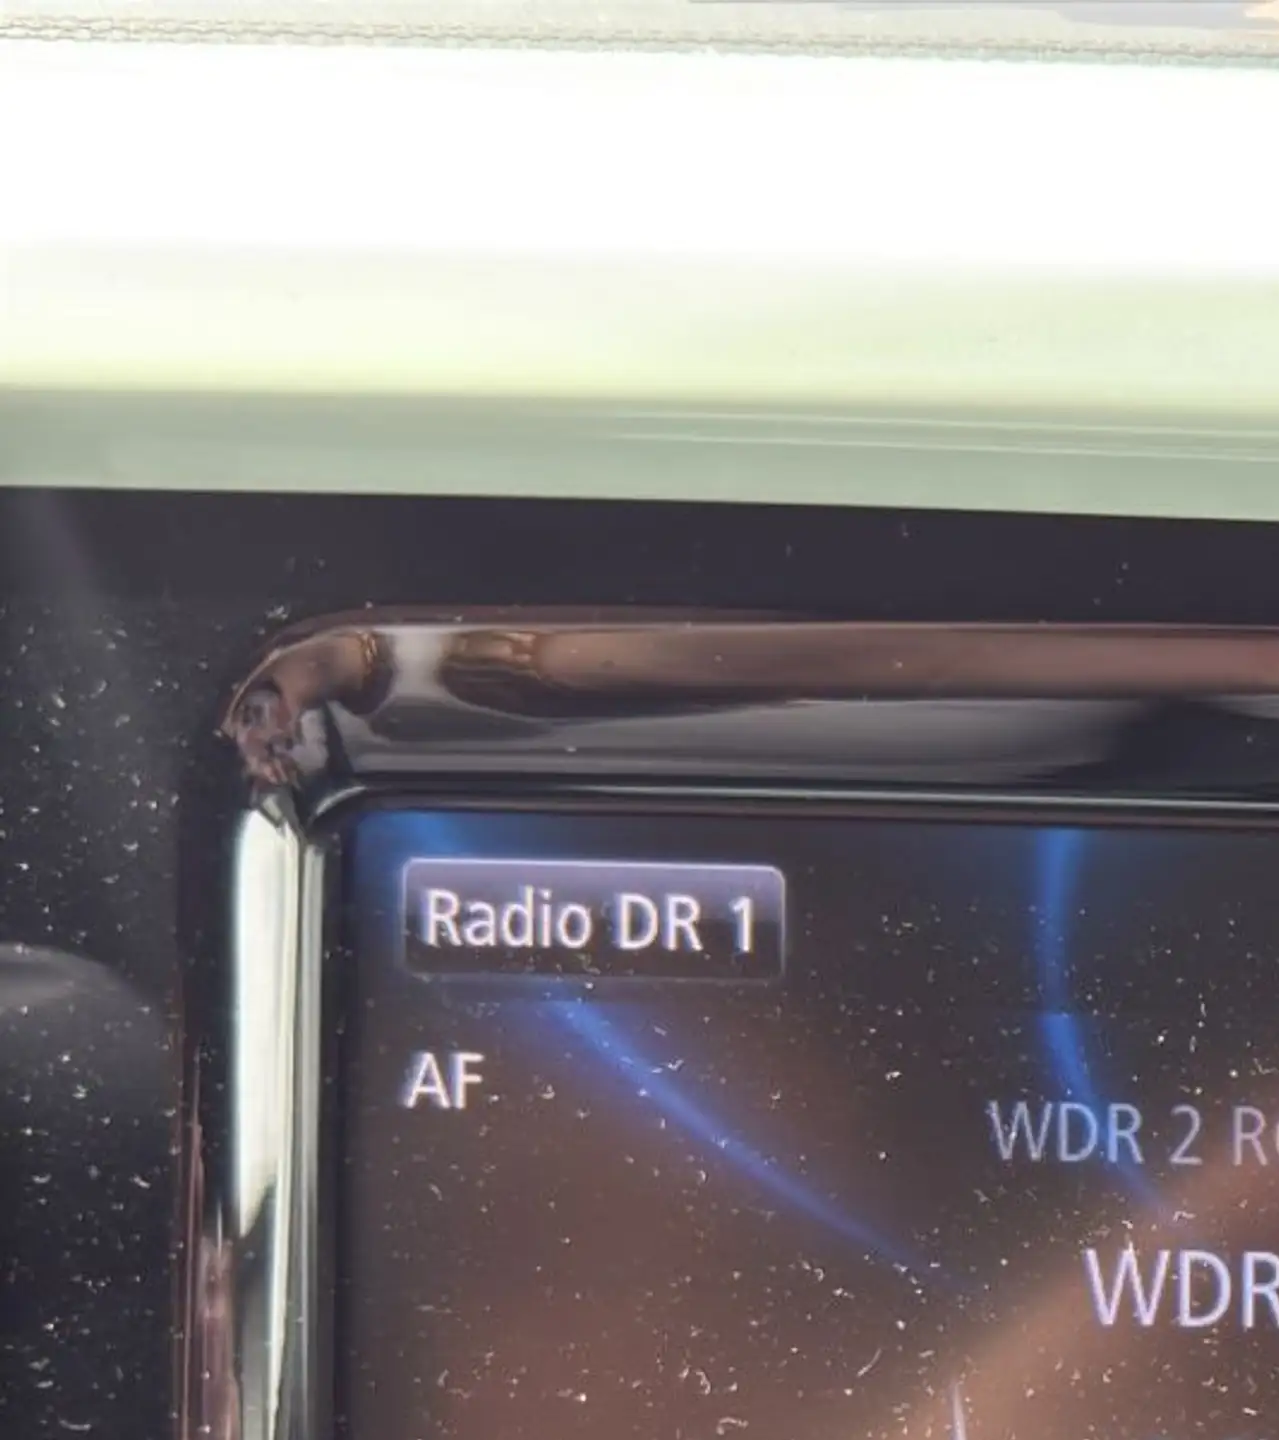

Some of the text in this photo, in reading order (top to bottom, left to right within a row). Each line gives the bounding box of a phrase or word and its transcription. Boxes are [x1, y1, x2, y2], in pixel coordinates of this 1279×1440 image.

[421, 888, 754, 953] Radio DR 1
[405, 1052, 482, 1108] AF
[990, 1101, 1142, 1164] WDR
[1172, 1105, 1199, 1164] 2
